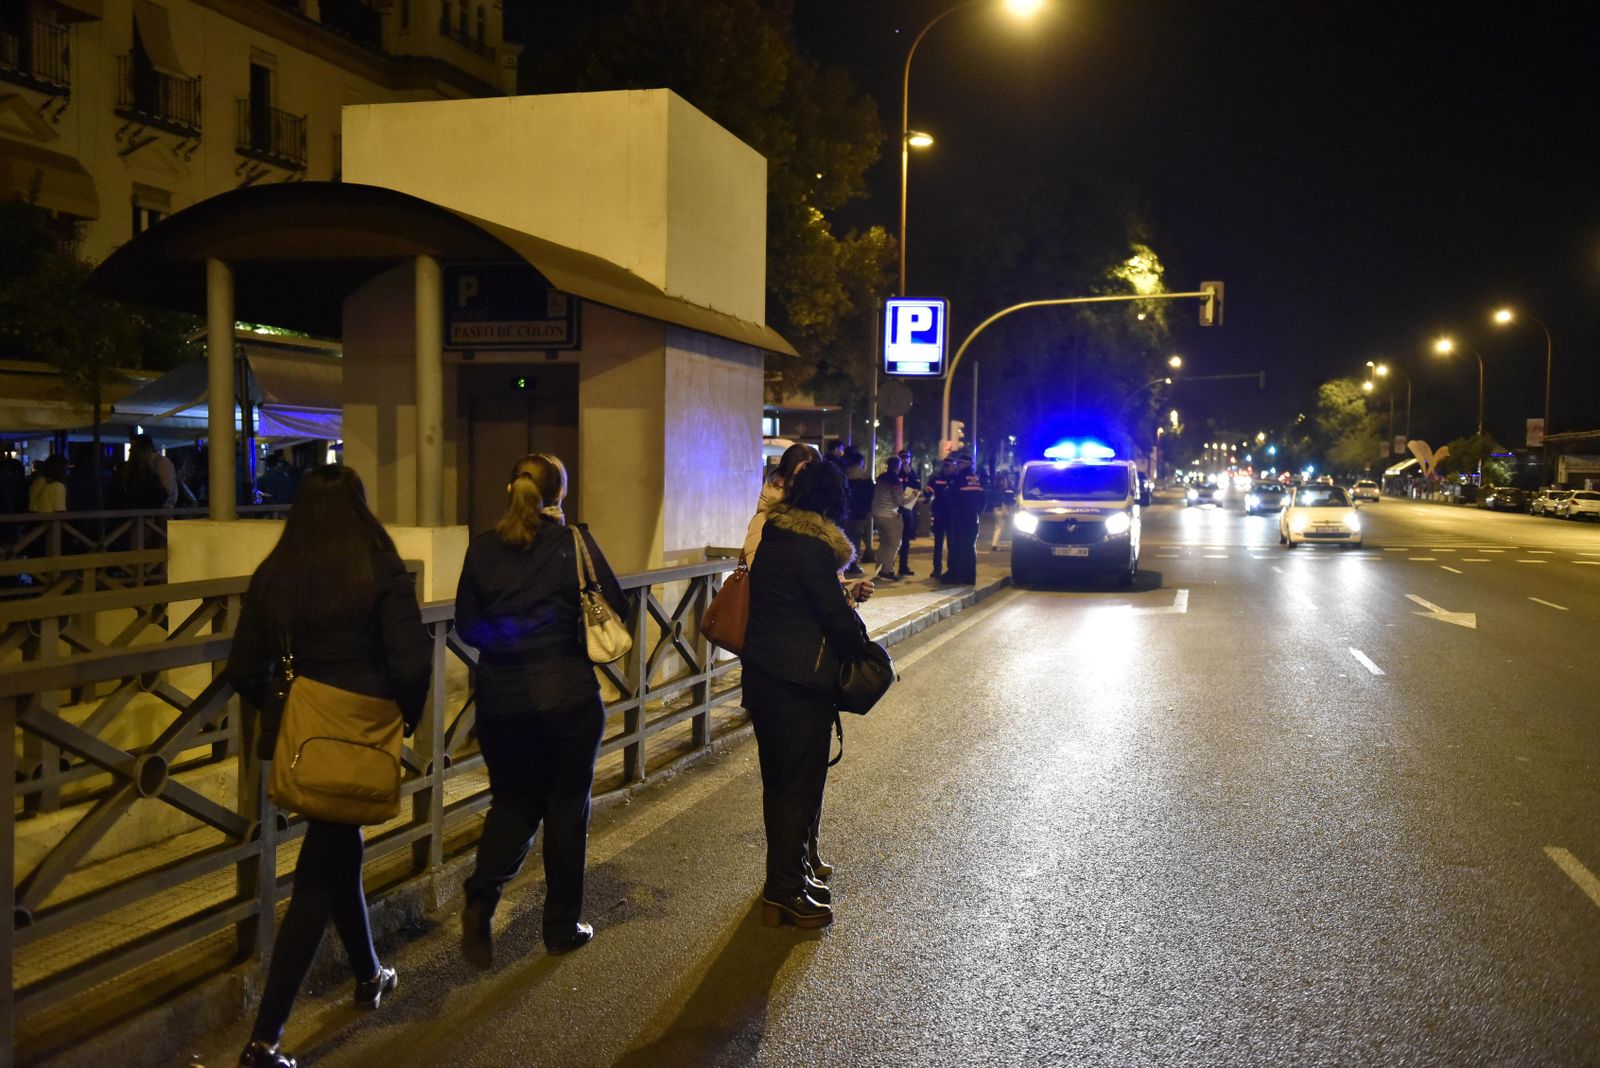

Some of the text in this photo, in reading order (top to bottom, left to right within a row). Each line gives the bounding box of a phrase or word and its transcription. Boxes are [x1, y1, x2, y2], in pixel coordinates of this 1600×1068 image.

[460, 274, 480, 306] P
[454, 326, 494, 338] PASEO
[497, 326, 512, 337] DE
[896, 306, 933, 345] P
